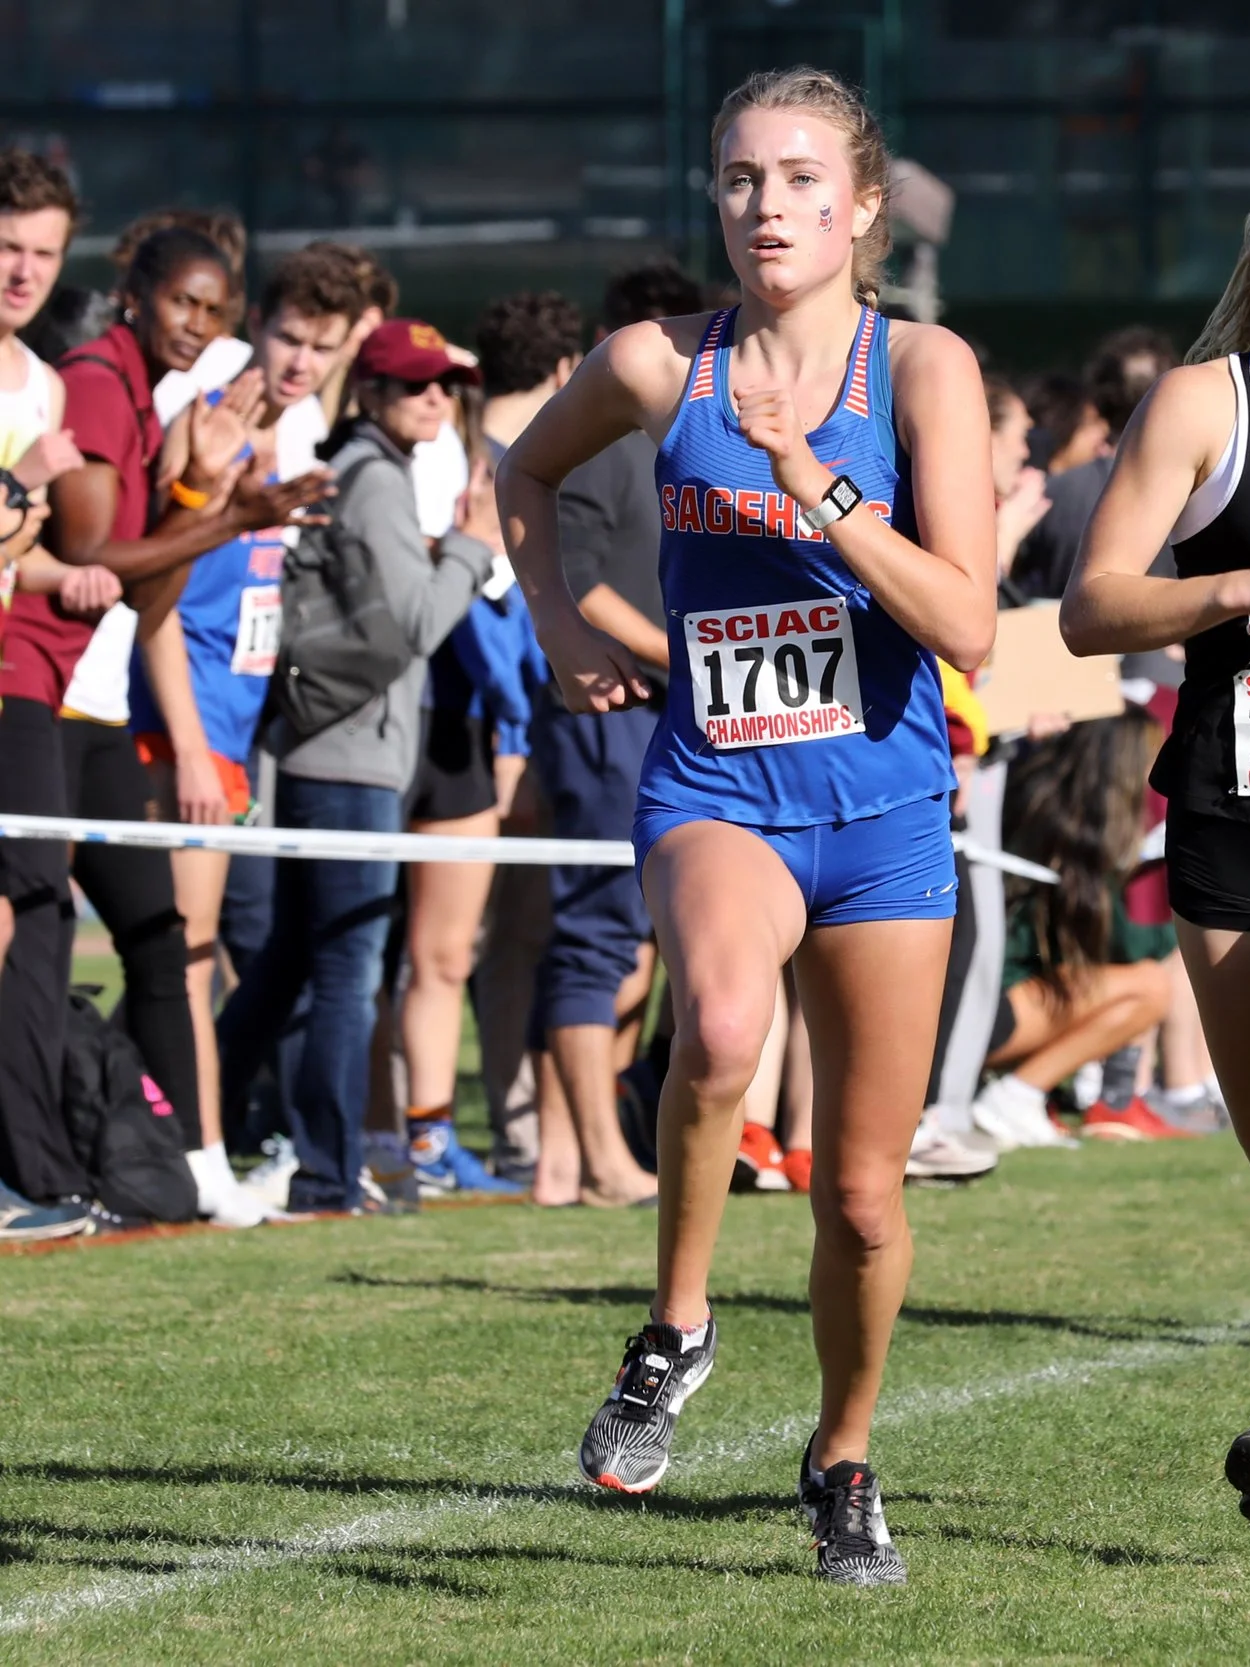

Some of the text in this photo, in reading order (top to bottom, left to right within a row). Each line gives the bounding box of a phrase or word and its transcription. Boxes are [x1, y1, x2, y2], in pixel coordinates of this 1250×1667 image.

[662, 484, 892, 543] SAGEHS
[697, 606, 840, 644] SCIAC
[704, 637, 844, 716] 1707
[706, 705, 851, 744] CHAMPIONSHIPS
